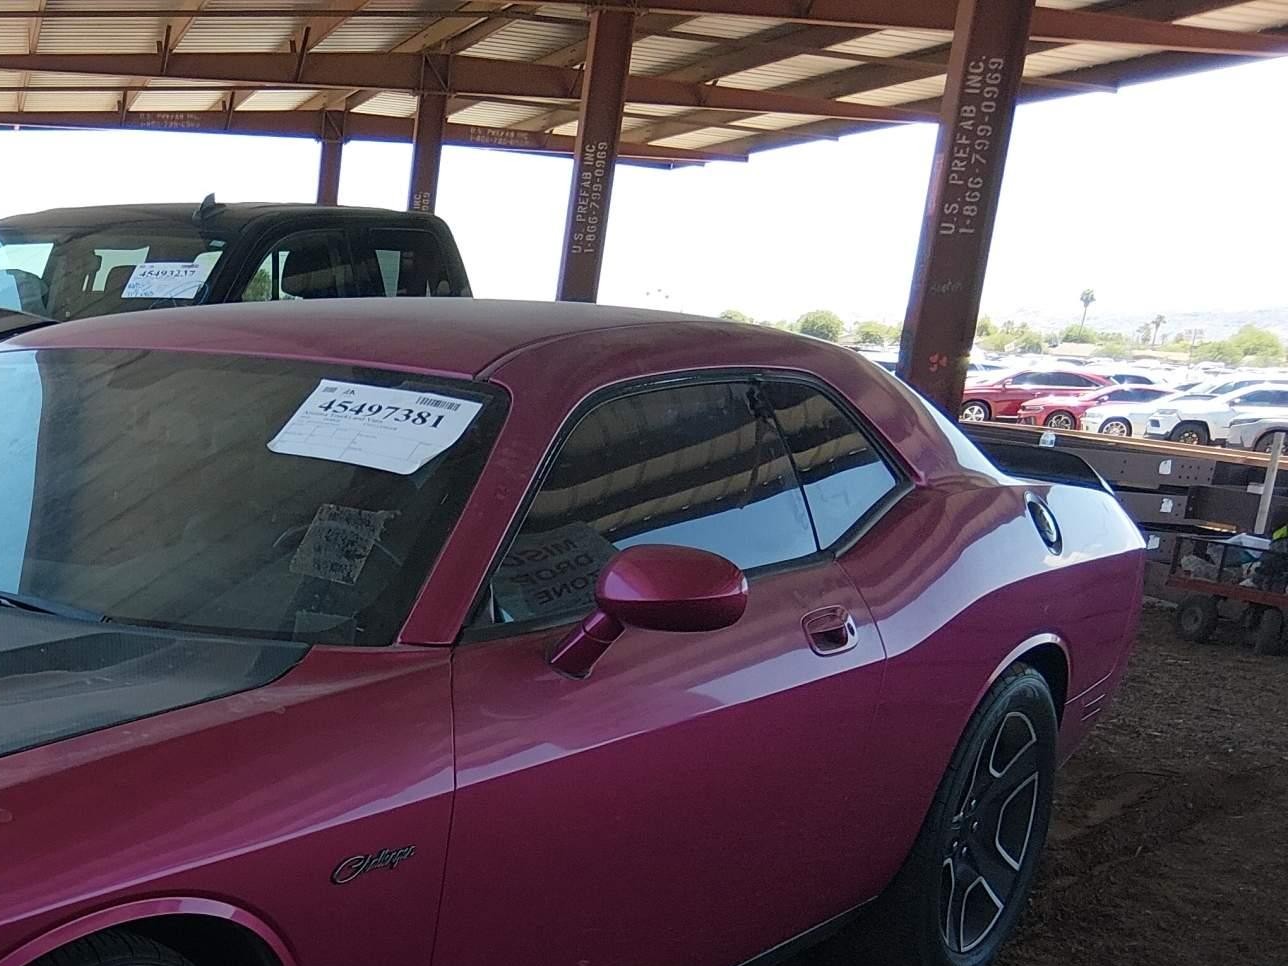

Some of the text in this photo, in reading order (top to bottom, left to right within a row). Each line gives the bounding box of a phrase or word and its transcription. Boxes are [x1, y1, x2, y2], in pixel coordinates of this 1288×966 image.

[576, 171, 592, 222] PREFAB
[584, 141, 608, 254] 1-866-799-0969
[940, 55, 986, 235] U.S. PREFAB INC.
[959, 57, 1004, 234] 1-866-799-0969
[318, 398, 445, 428] 45497381
